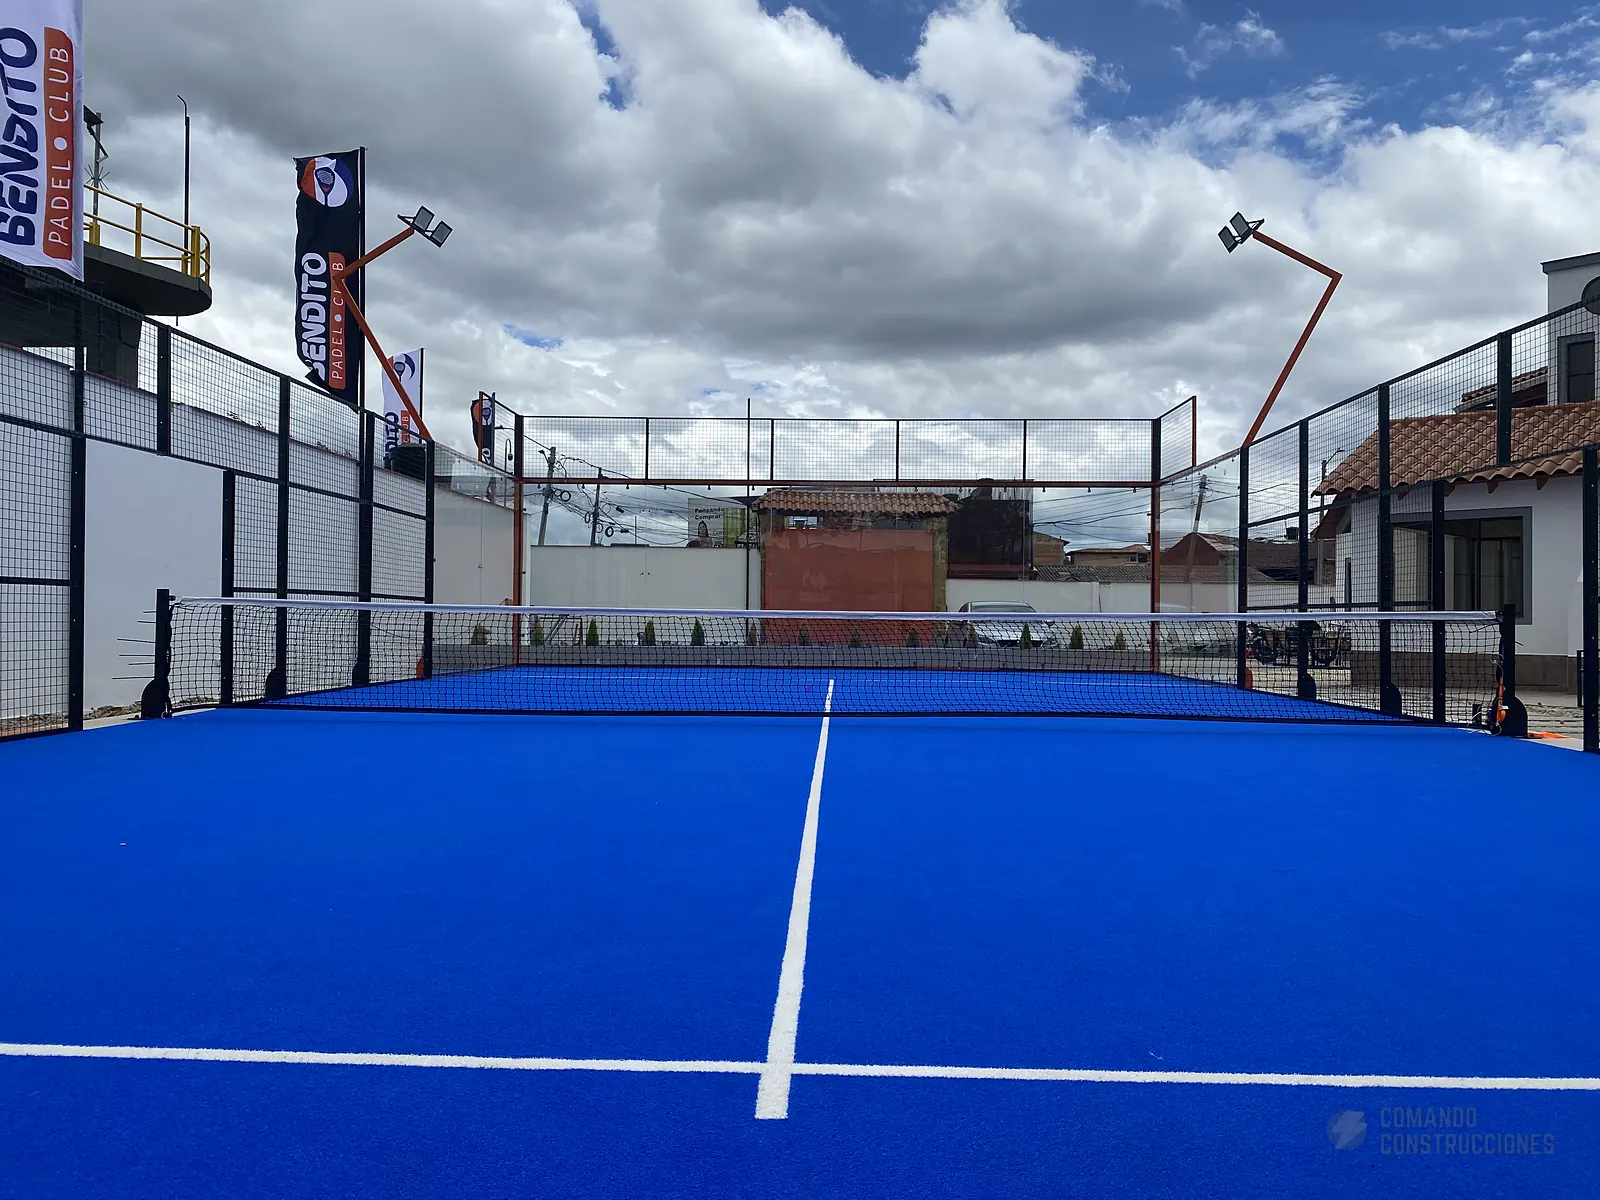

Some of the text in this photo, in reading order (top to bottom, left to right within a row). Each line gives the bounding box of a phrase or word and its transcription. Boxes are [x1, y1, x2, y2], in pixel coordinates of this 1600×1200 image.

[48, 47, 71, 246] PADEL CLUB
[331, 262, 344, 380] PADEL CLB
